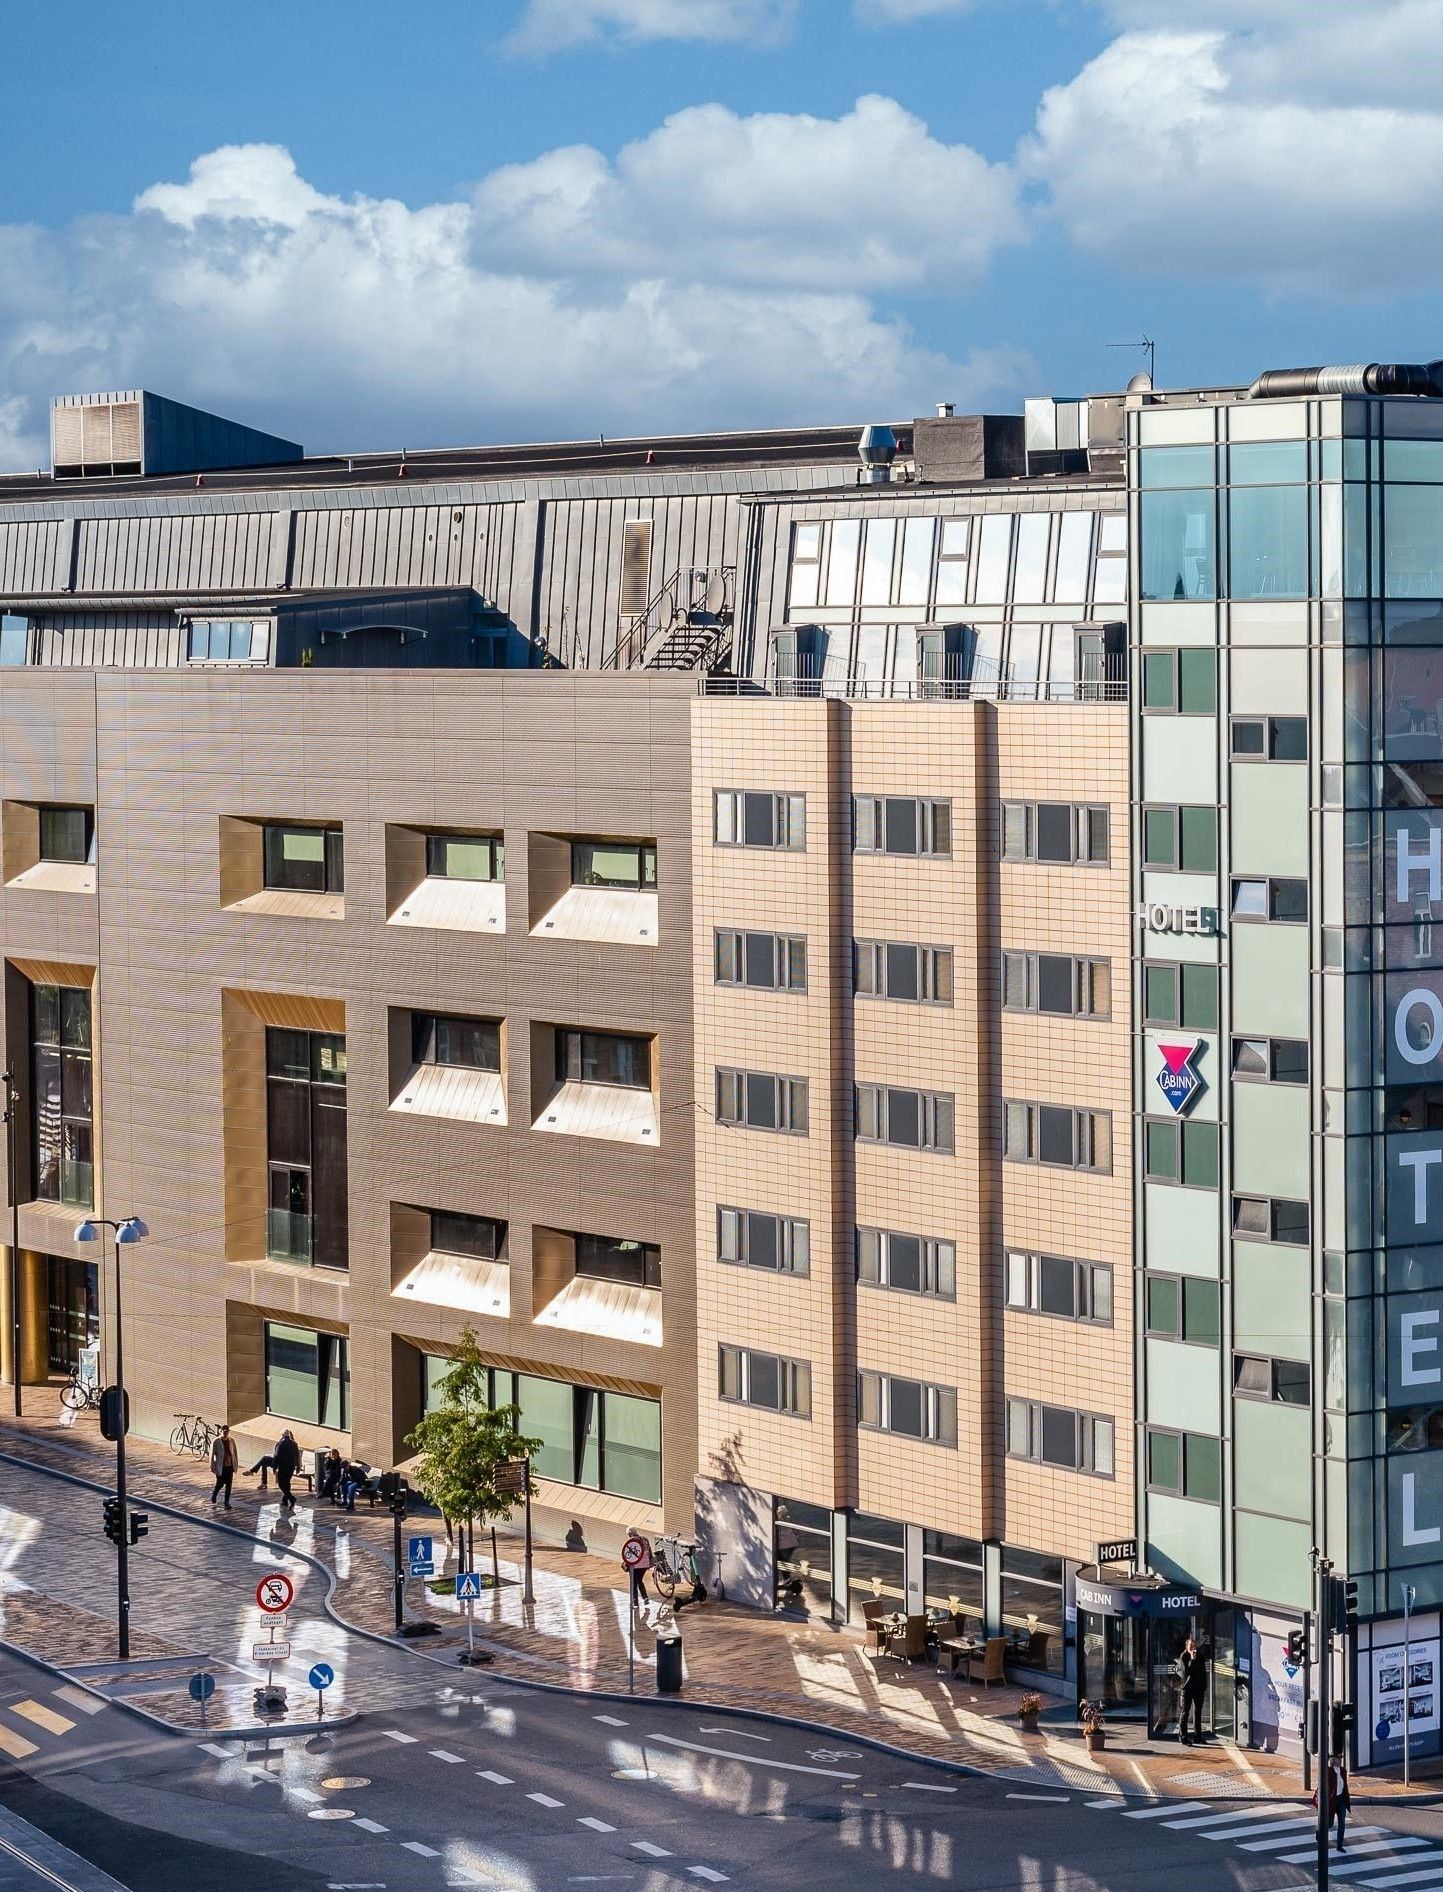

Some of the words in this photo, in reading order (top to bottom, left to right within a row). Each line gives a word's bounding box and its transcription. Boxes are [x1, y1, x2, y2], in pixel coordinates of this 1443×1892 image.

[1137, 903, 1210, 933] HOTEL
[1160, 1070, 1192, 1090] CABINN
[1100, 1543, 1136, 1560] HOTEL
[1162, 1595, 1201, 1608] HOTEL
